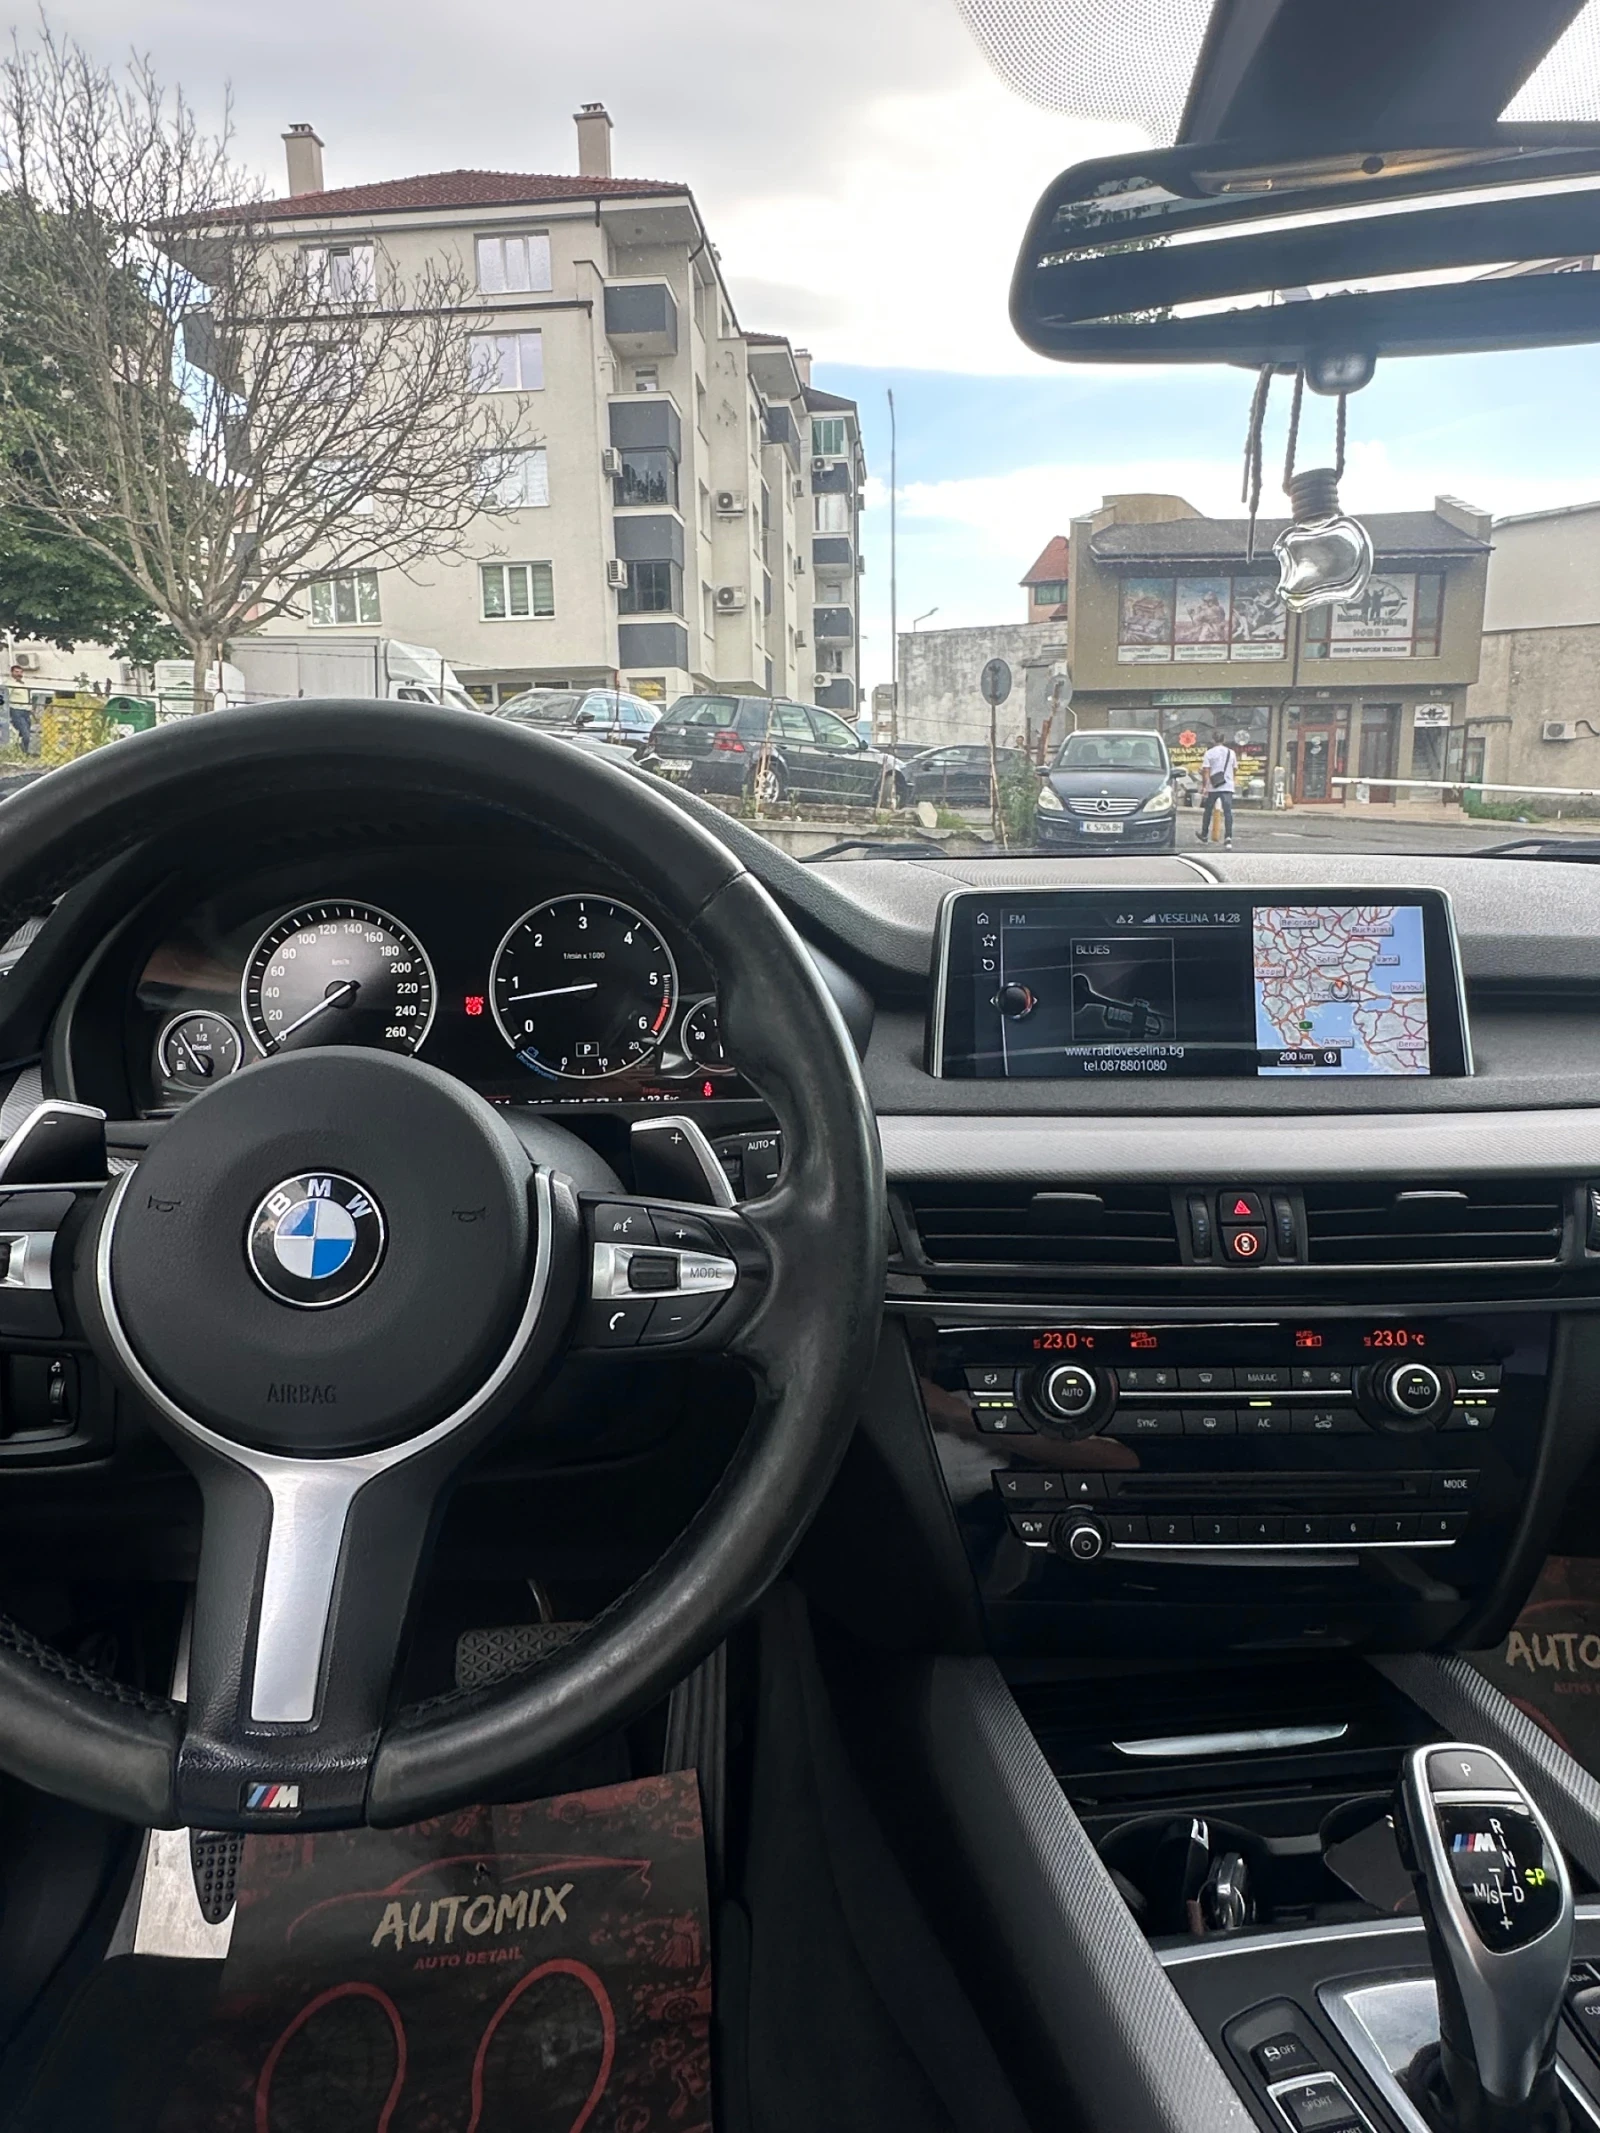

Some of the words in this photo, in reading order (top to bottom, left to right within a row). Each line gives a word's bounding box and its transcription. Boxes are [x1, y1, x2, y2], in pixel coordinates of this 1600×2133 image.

[578, 916, 588, 930] 3
[1009, 914, 1026, 925] FM
[1127, 914, 1134, 924] 2
[1159, 913, 1209, 924] VESELINA
[1213, 913, 1241, 923] 14:28
[318, 924, 337, 935] 120
[343, 924, 362, 935] 140
[297, 934, 316, 945] 100
[364, 932, 383, 943] 160
[534, 934, 543, 947] 2
[623, 931, 633, 944] 4
[282, 948, 296, 959] 80
[380, 946, 399, 957] 180
[1076, 945, 1110, 955] BLUES
[588, 952, 606, 960] 1000
[271, 966, 285, 977] 60
[390, 963, 412, 974] 200
[512, 976, 519, 989] 1
[649, 972, 658, 985] 5
[265, 987, 280, 998] 40
[397, 983, 418, 994] 220
[268, 1010, 283, 1021] 20
[395, 1005, 417, 1017] 240
[524, 1020, 534, 1032] 0
[638, 1016, 648, 1030] 6
[385, 1026, 407, 1038] 260
[694, 1031, 706, 1040] 50
[196, 1034, 208, 1042] 1/2
[177, 1047, 184, 1055] 0
[192, 1043, 212, 1051] Diesel
[583, 1044, 592, 1055] P
[628, 1041, 640, 1050] 20
[1065, 1045, 1185, 1058] www.radioveselina.bg
[1279, 1052, 1297, 1061] 200
[1299, 1051, 1314, 1061] km
[561, 1057, 568, 1066] 0
[598, 1058, 609, 1066] 10
[1084, 1060, 1167, 1072] tel.0878801080
[748, 1139, 769, 1151] AUTO
[267, 1178, 373, 1219] BMW
[689, 1267, 723, 1279] MODE
[1043, 1332, 1078, 1349] 23.0
[1373, 1330, 1408, 1347] 23.0
[267, 1383, 337, 1405] AIRBAG
[1061, 1387, 1084, 1398] AUTO
[1407, 1385, 1431, 1396] AUTO
[1136, 1418, 1159, 1429] SYNC
[1257, 1418, 1271, 1428] A/C
[1443, 1479, 1468, 1490] MODE
[1127, 1524, 1133, 1533] 1
[1168, 1524, 1175, 1533] 2
[1214, 1524, 1221, 1533] 3
[1259, 1524, 1266, 1533] 4
[1305, 1524, 1311, 1533] 5
[1350, 1523, 1357, 1532] 6
[1396, 1522, 1402, 1531] 7
[1441, 1521, 1447, 1530] 8
[1460, 1762, 1472, 1777] P
[1489, 1817, 1505, 1835] R
[1501, 1850, 1517, 1868] N
[1534, 1868, 1546, 1886] P
[1512, 1885, 1525, 1903] D
[371, 1883, 574, 1951] AUTOMIX
[413, 1954, 460, 1971] AUTO
[465, 1947, 524, 1965] DETAIL
[1280, 2044, 1296, 2055] OFF
[1302, 2095, 1332, 2112] SPORT
